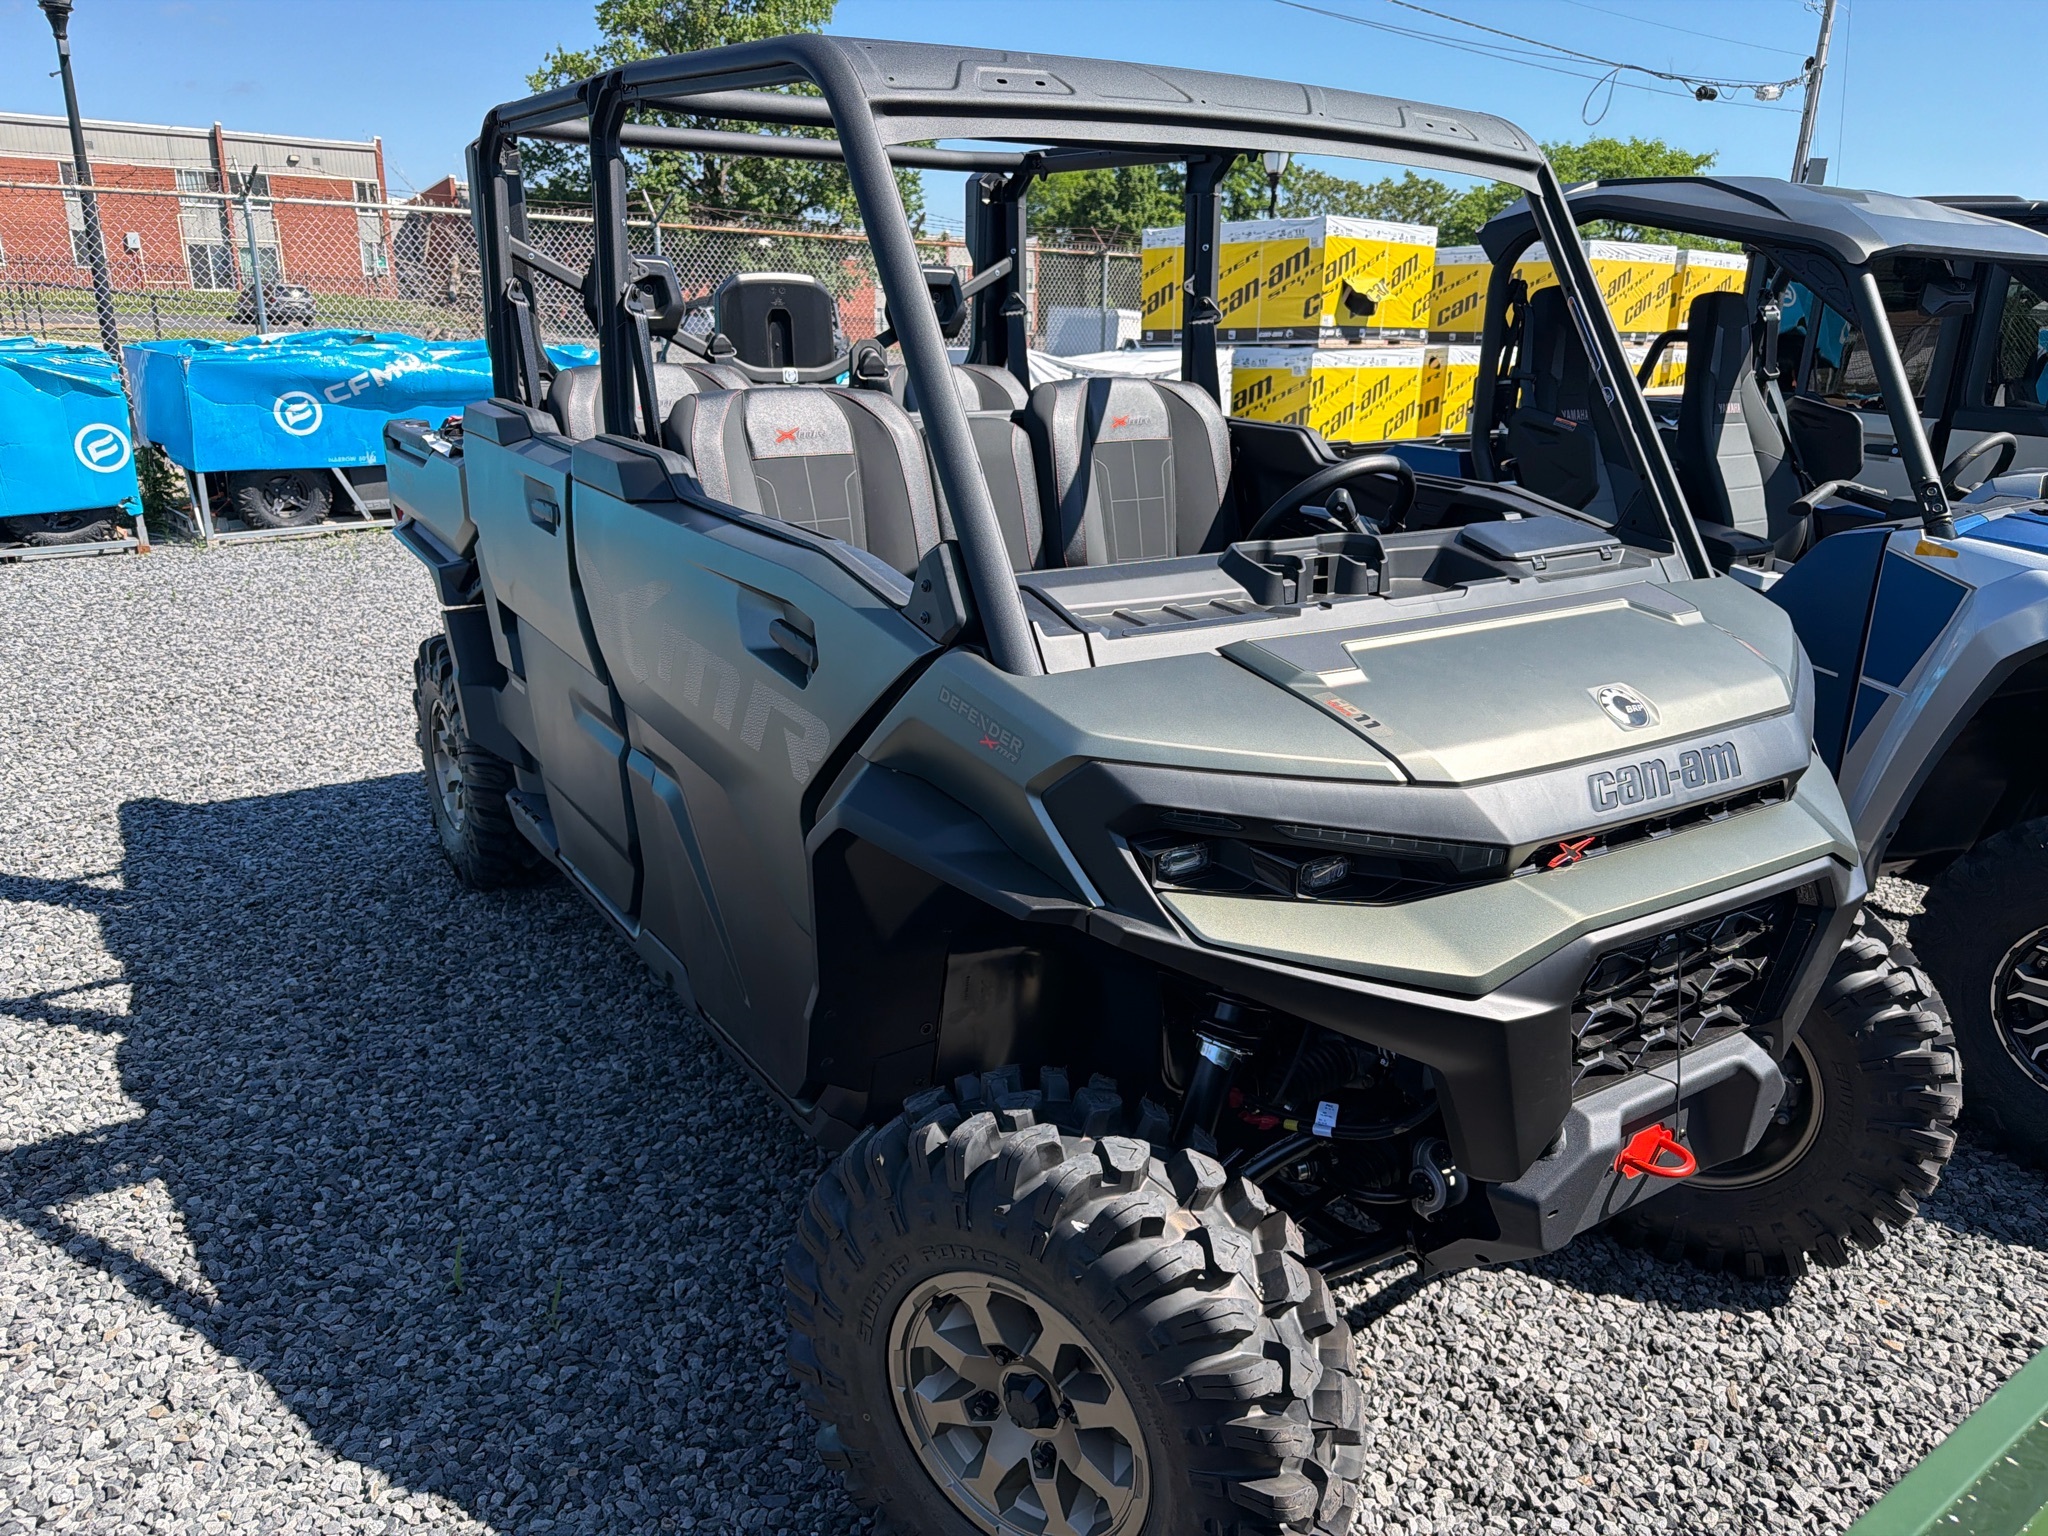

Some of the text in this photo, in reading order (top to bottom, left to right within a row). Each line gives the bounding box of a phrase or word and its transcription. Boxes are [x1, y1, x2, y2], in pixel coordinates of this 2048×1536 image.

[1217, 246, 1310, 318] can-am
[1320, 374, 1390, 441] can-am
[1561, 408, 1590, 421] YAMAHA
[1718, 402, 1741, 414] YAMAHA
[939, 677, 1024, 755] DEFENDER
[1625, 702, 1644, 714] BRP
[1587, 741, 1742, 813] can-am
[857, 1243, 1022, 1345] SWAMP FORCE
